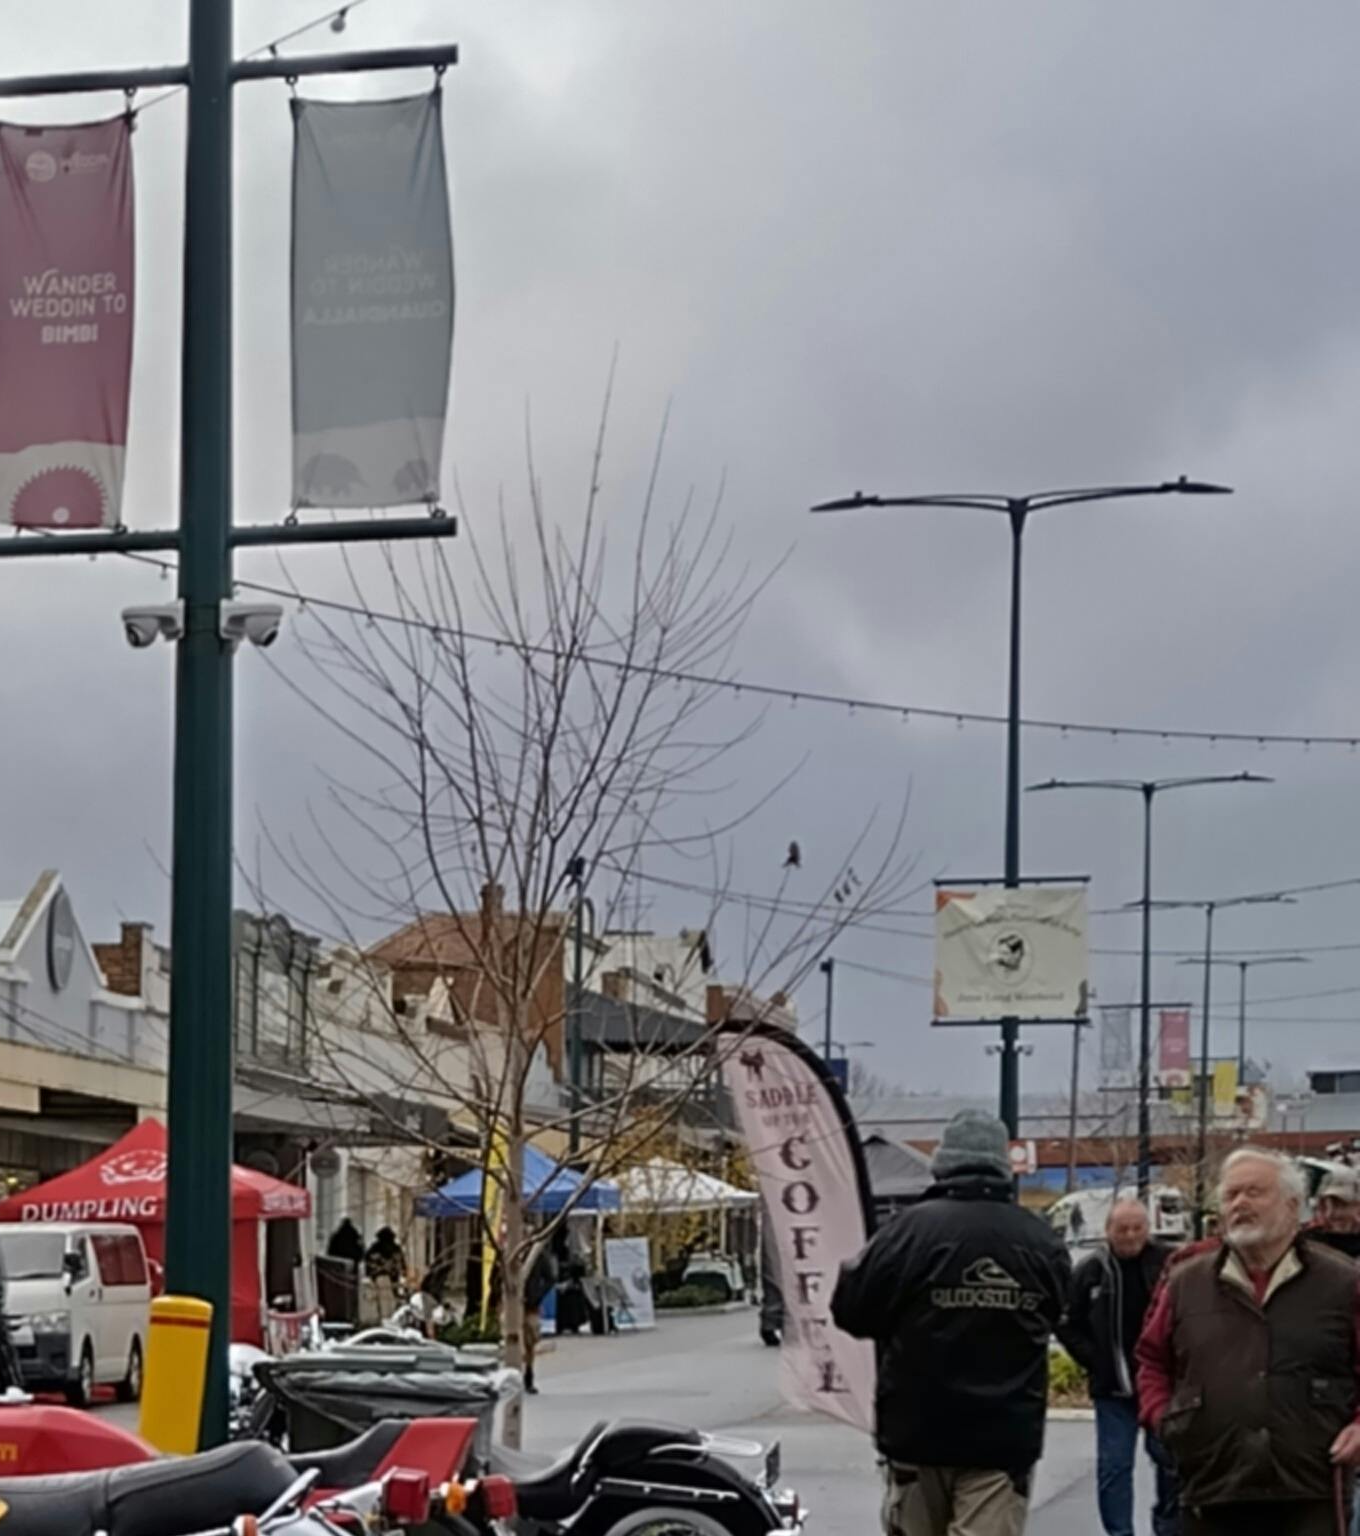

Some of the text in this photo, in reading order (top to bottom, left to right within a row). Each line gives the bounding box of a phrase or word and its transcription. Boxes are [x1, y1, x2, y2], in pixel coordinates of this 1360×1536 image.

[23, 268, 116, 295] WANDER
[10, 293, 127, 318] WEDDIN TO
[41, 324, 99, 344] BIMBI
[21, 1196, 159, 1223] DUMPLING
